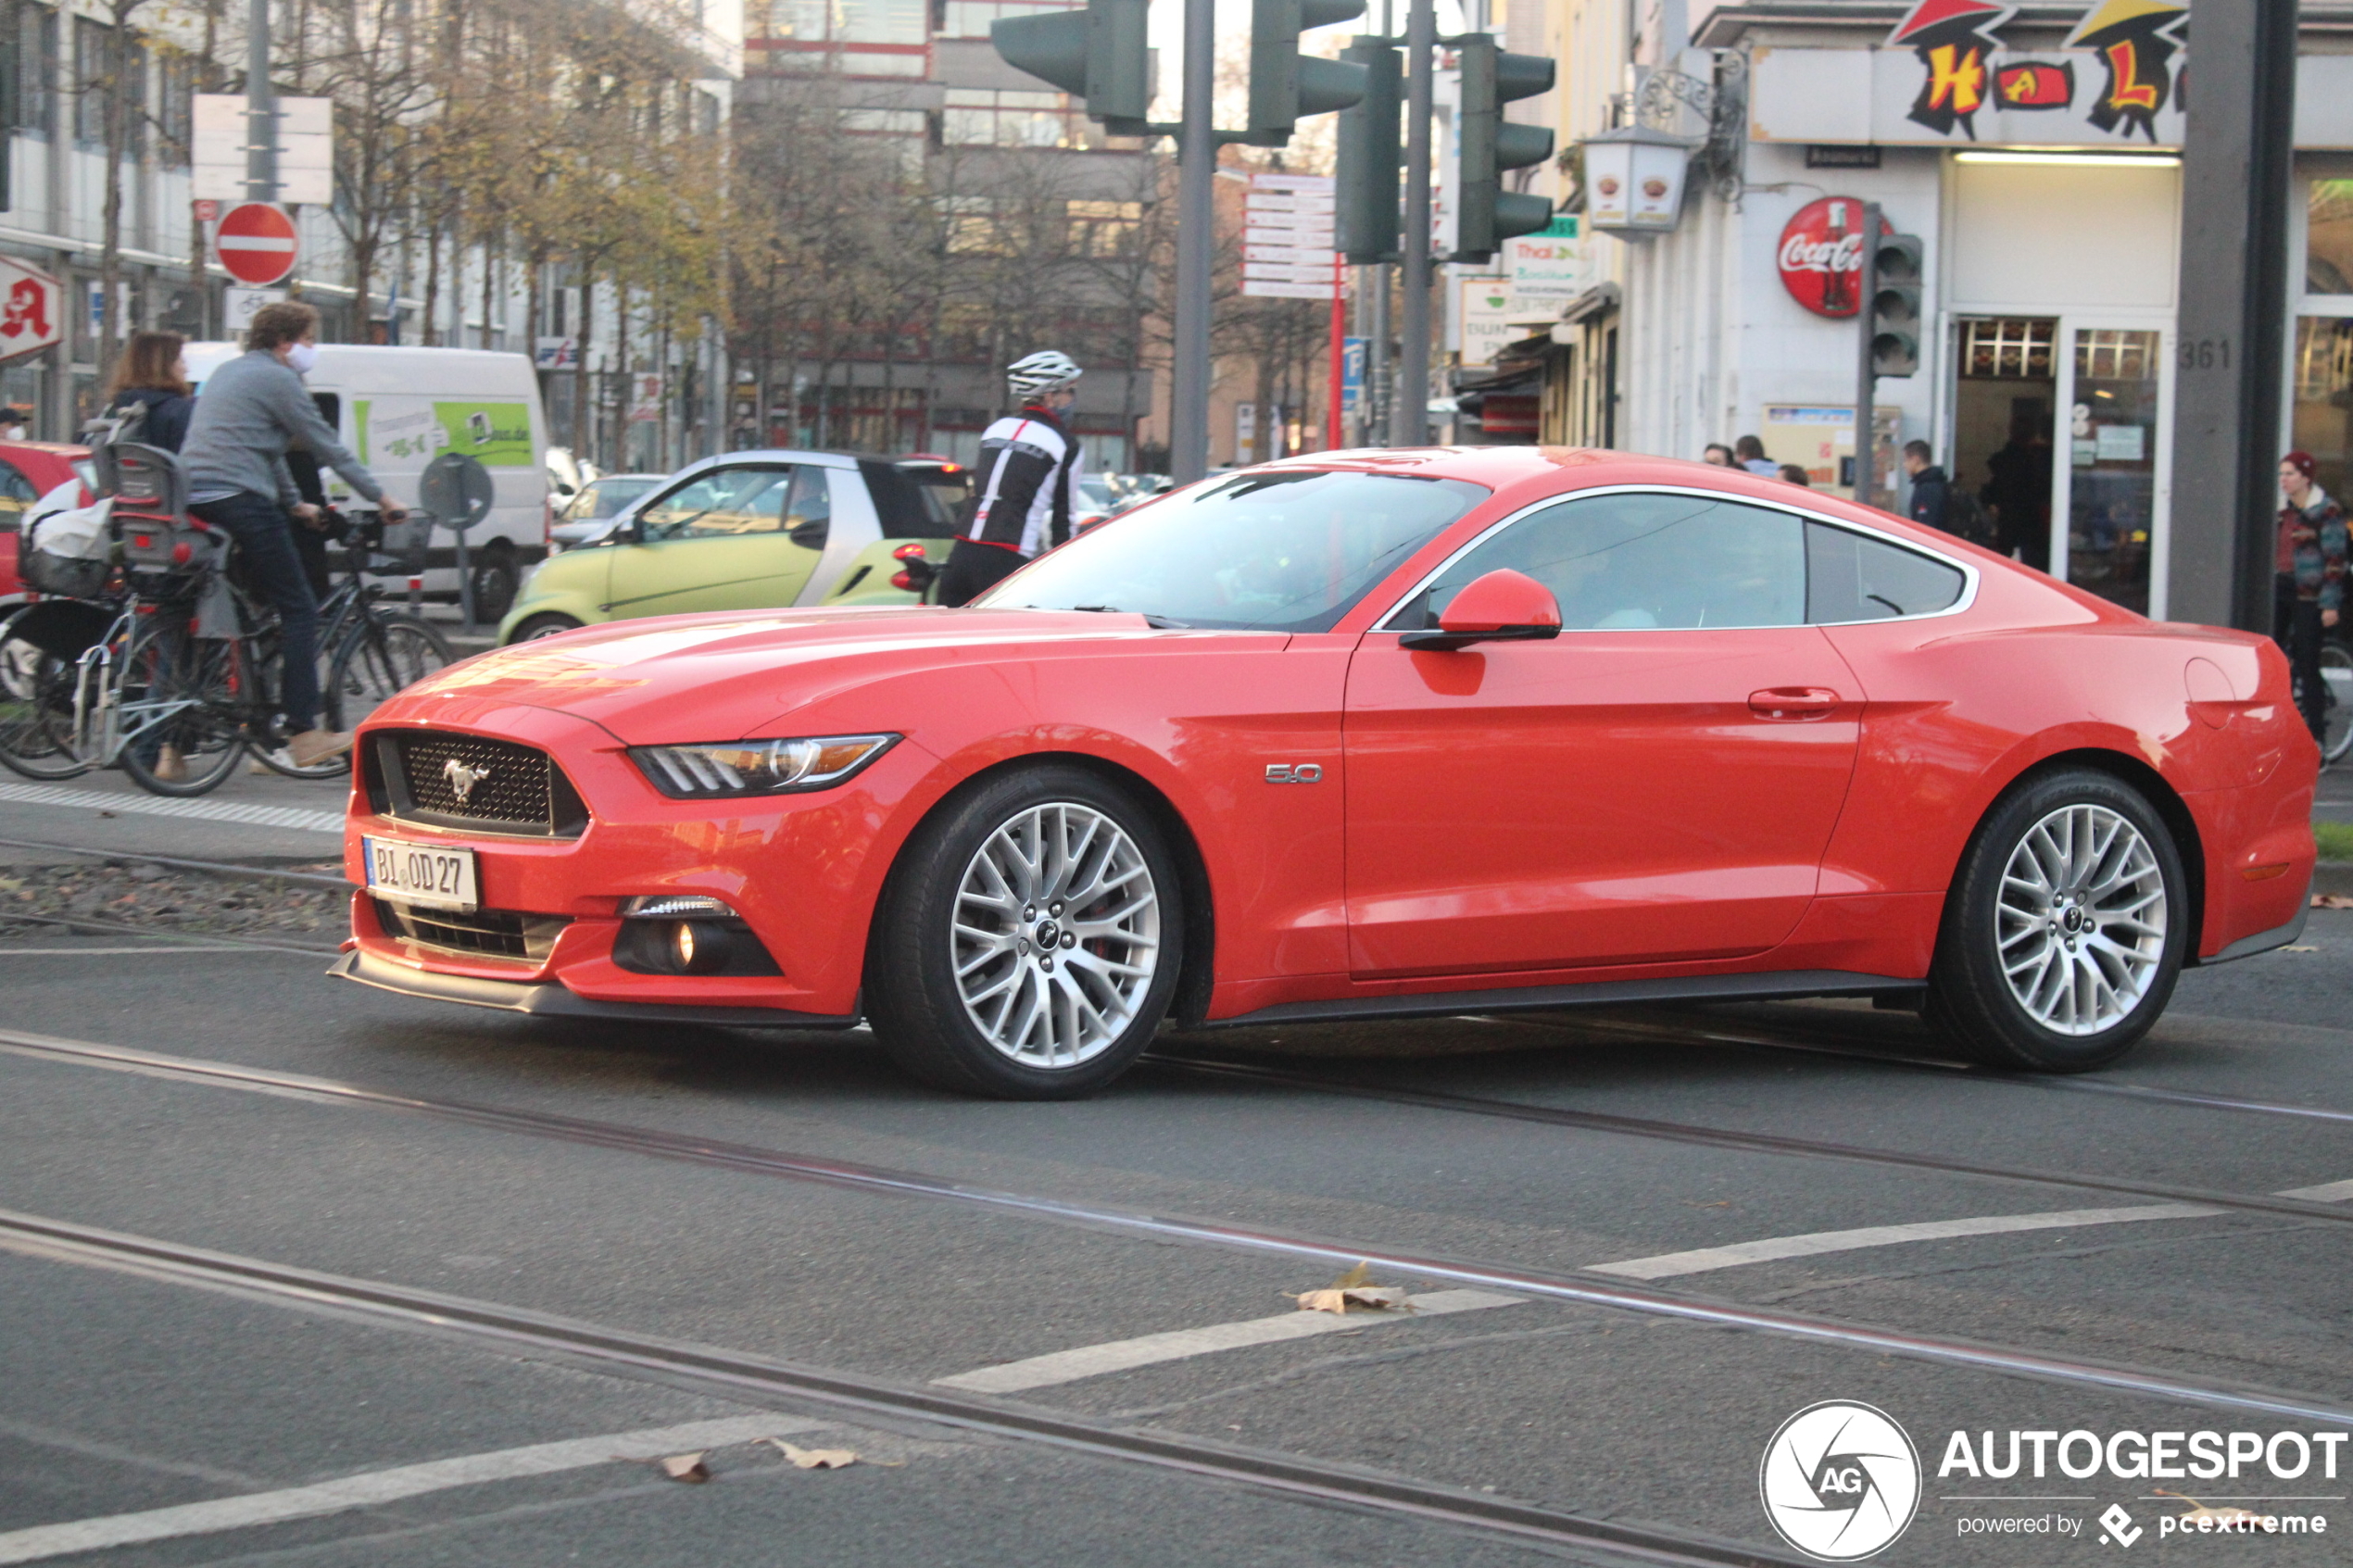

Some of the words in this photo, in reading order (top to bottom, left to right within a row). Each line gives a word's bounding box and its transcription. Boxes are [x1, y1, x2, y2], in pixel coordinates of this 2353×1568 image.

[1516, 243, 1554, 259] Thai
[1779, 232, 1863, 272] Coca-Co
[2179, 339, 2229, 370] 361
[1265, 763, 1323, 784] 5.0
[376, 846, 399, 886] BI
